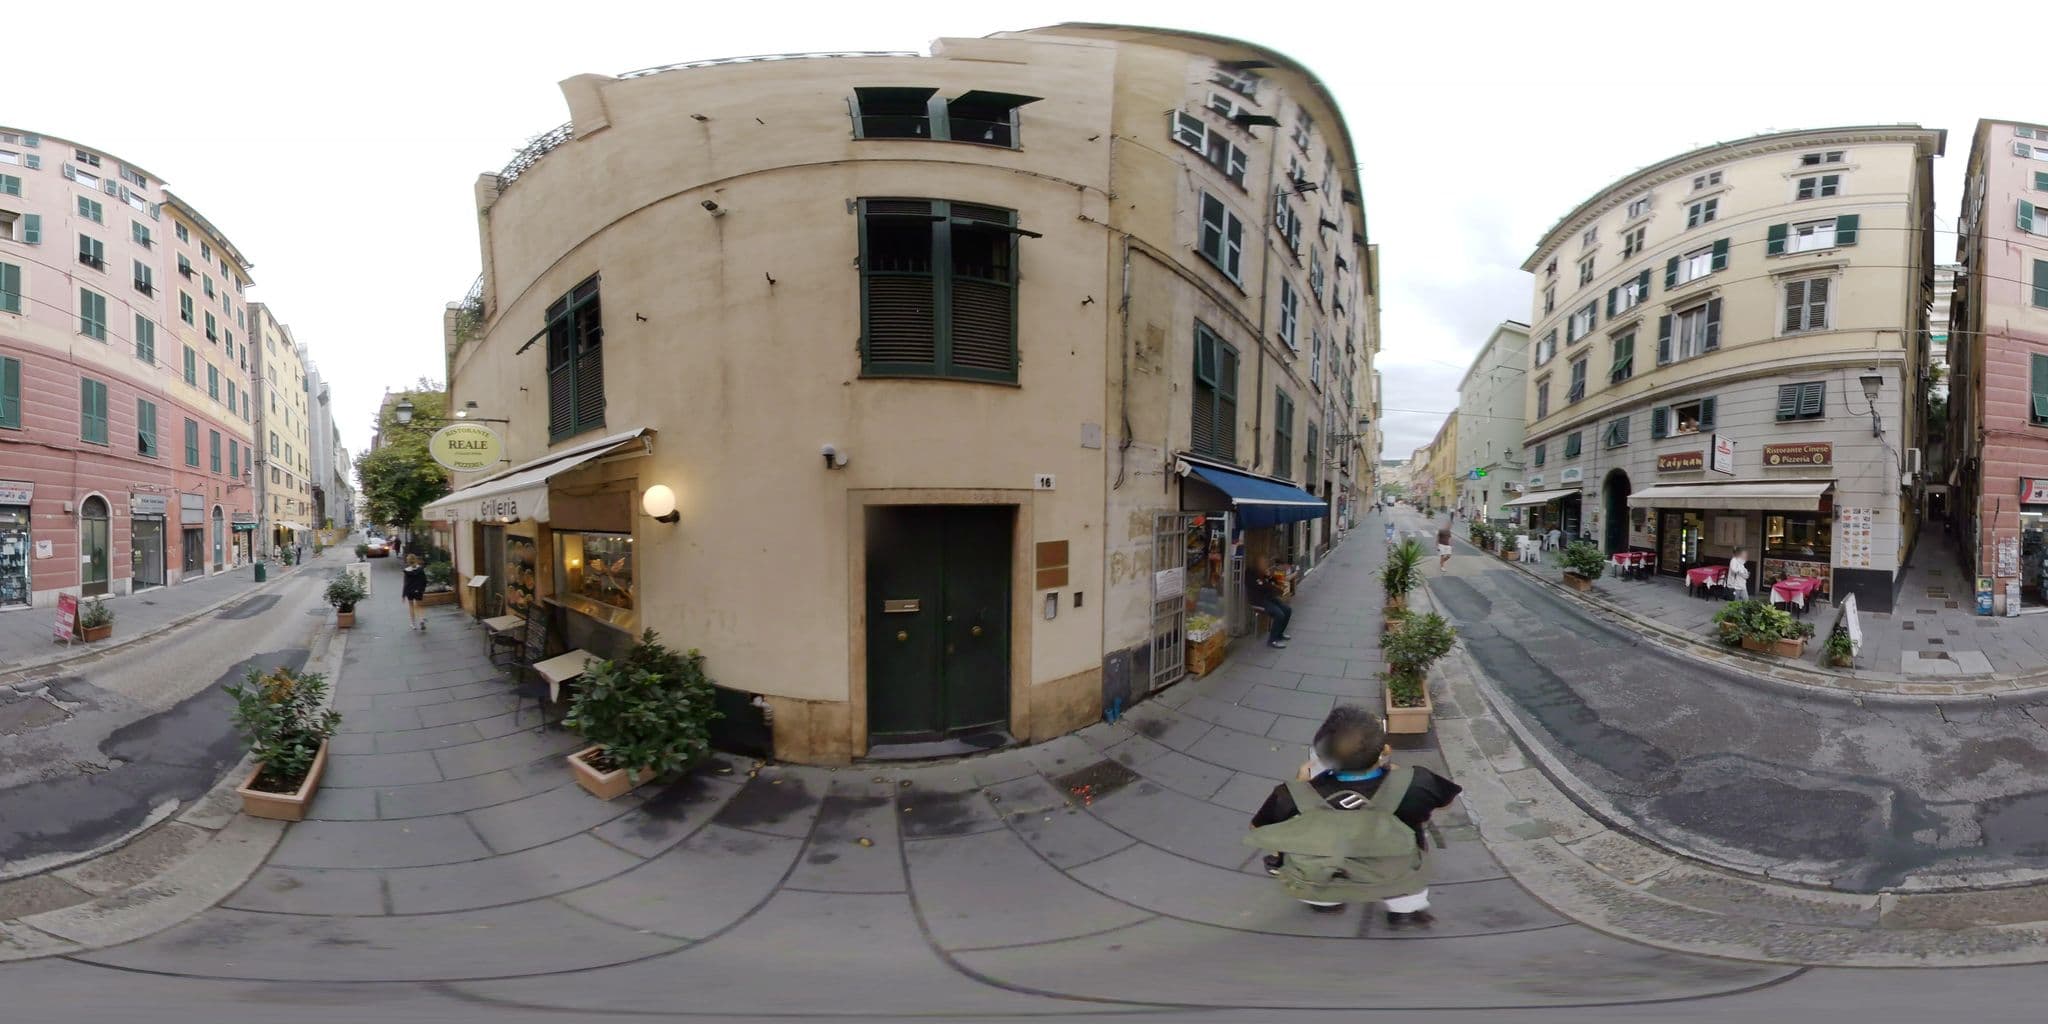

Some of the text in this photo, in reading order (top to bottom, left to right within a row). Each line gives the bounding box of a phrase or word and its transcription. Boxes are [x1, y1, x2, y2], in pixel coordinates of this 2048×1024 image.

[445, 428, 489, 437] RISTORANTE
[448, 440, 488, 449] REALE
[1658, 458, 1702, 469] Kaiyuan
[1040, 477, 1051, 488] 16
